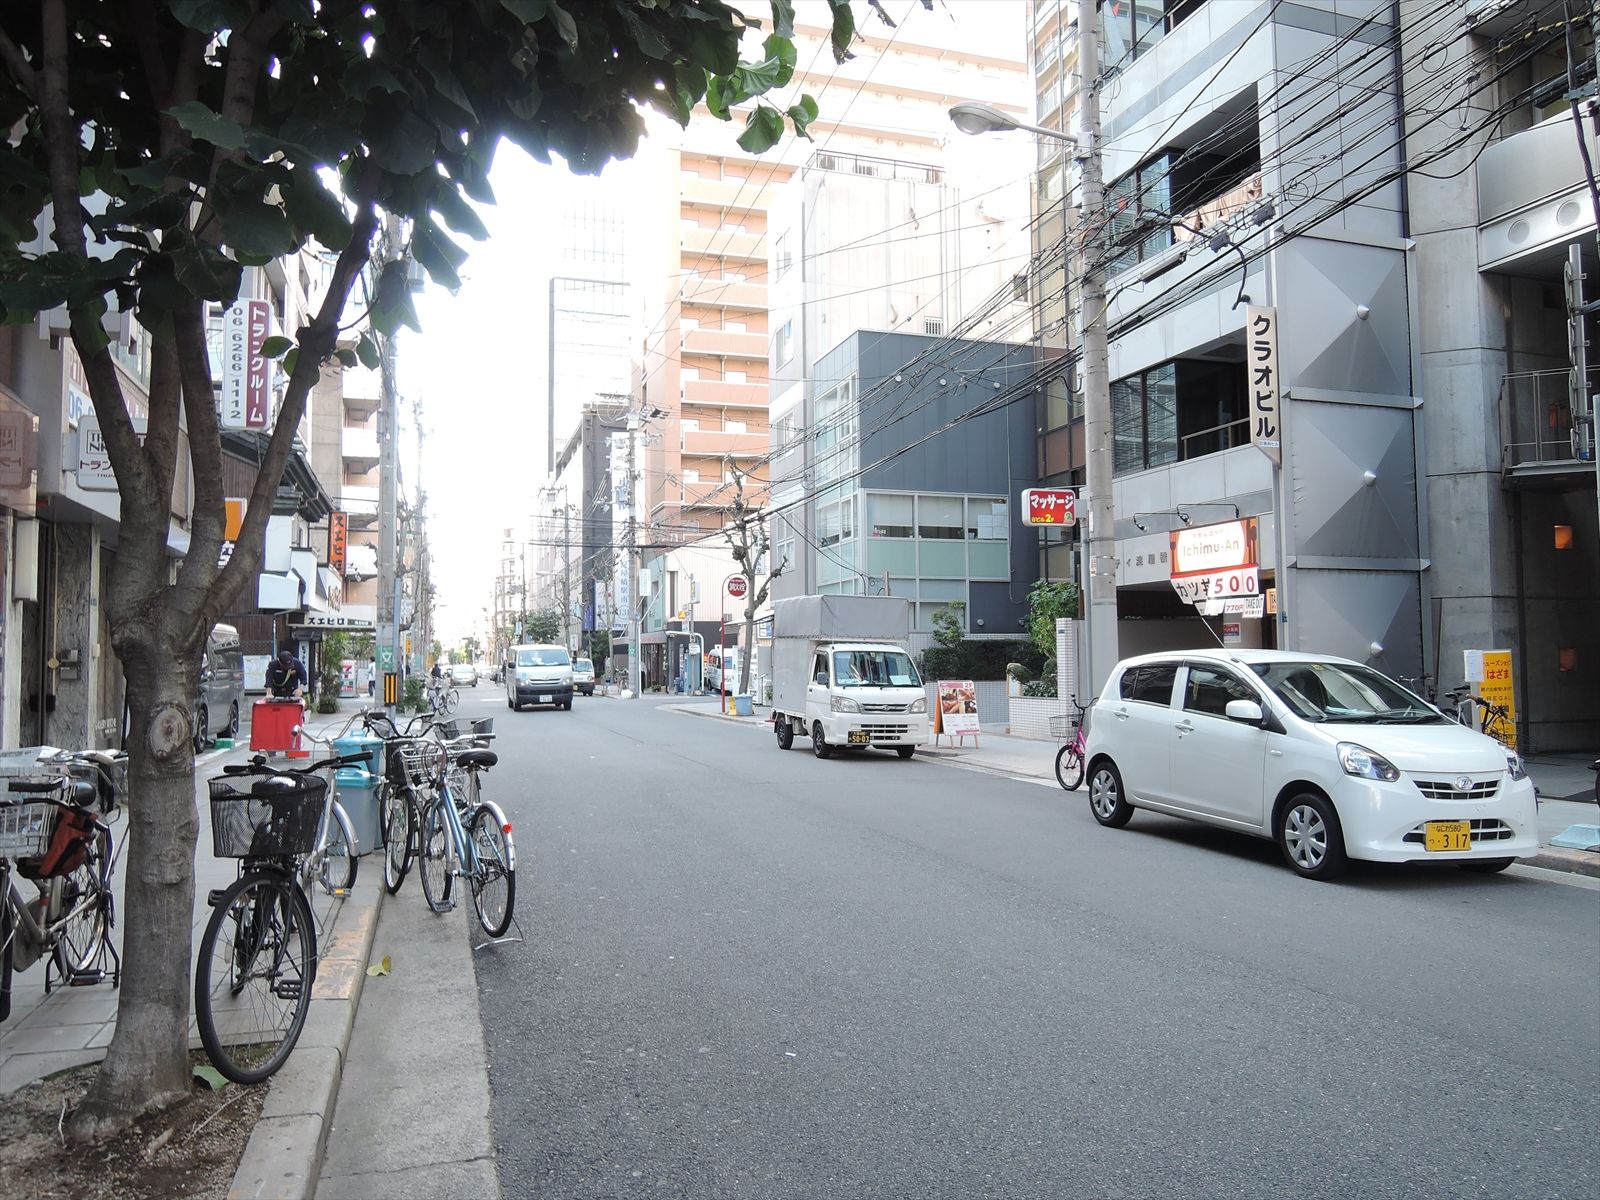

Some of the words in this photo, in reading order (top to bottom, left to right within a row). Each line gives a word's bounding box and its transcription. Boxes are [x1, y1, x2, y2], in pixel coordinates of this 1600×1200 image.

[252, 306, 266, 422] トランクルーム
[1253, 314, 1276, 438] クラオビル
[1030, 493, 1074, 510] マッサージ
[1183, 539, 1239, 556] Ichimu-An
[307, 616, 345, 626] スエヒロ
[1486, 669, 1510, 680] はざま
